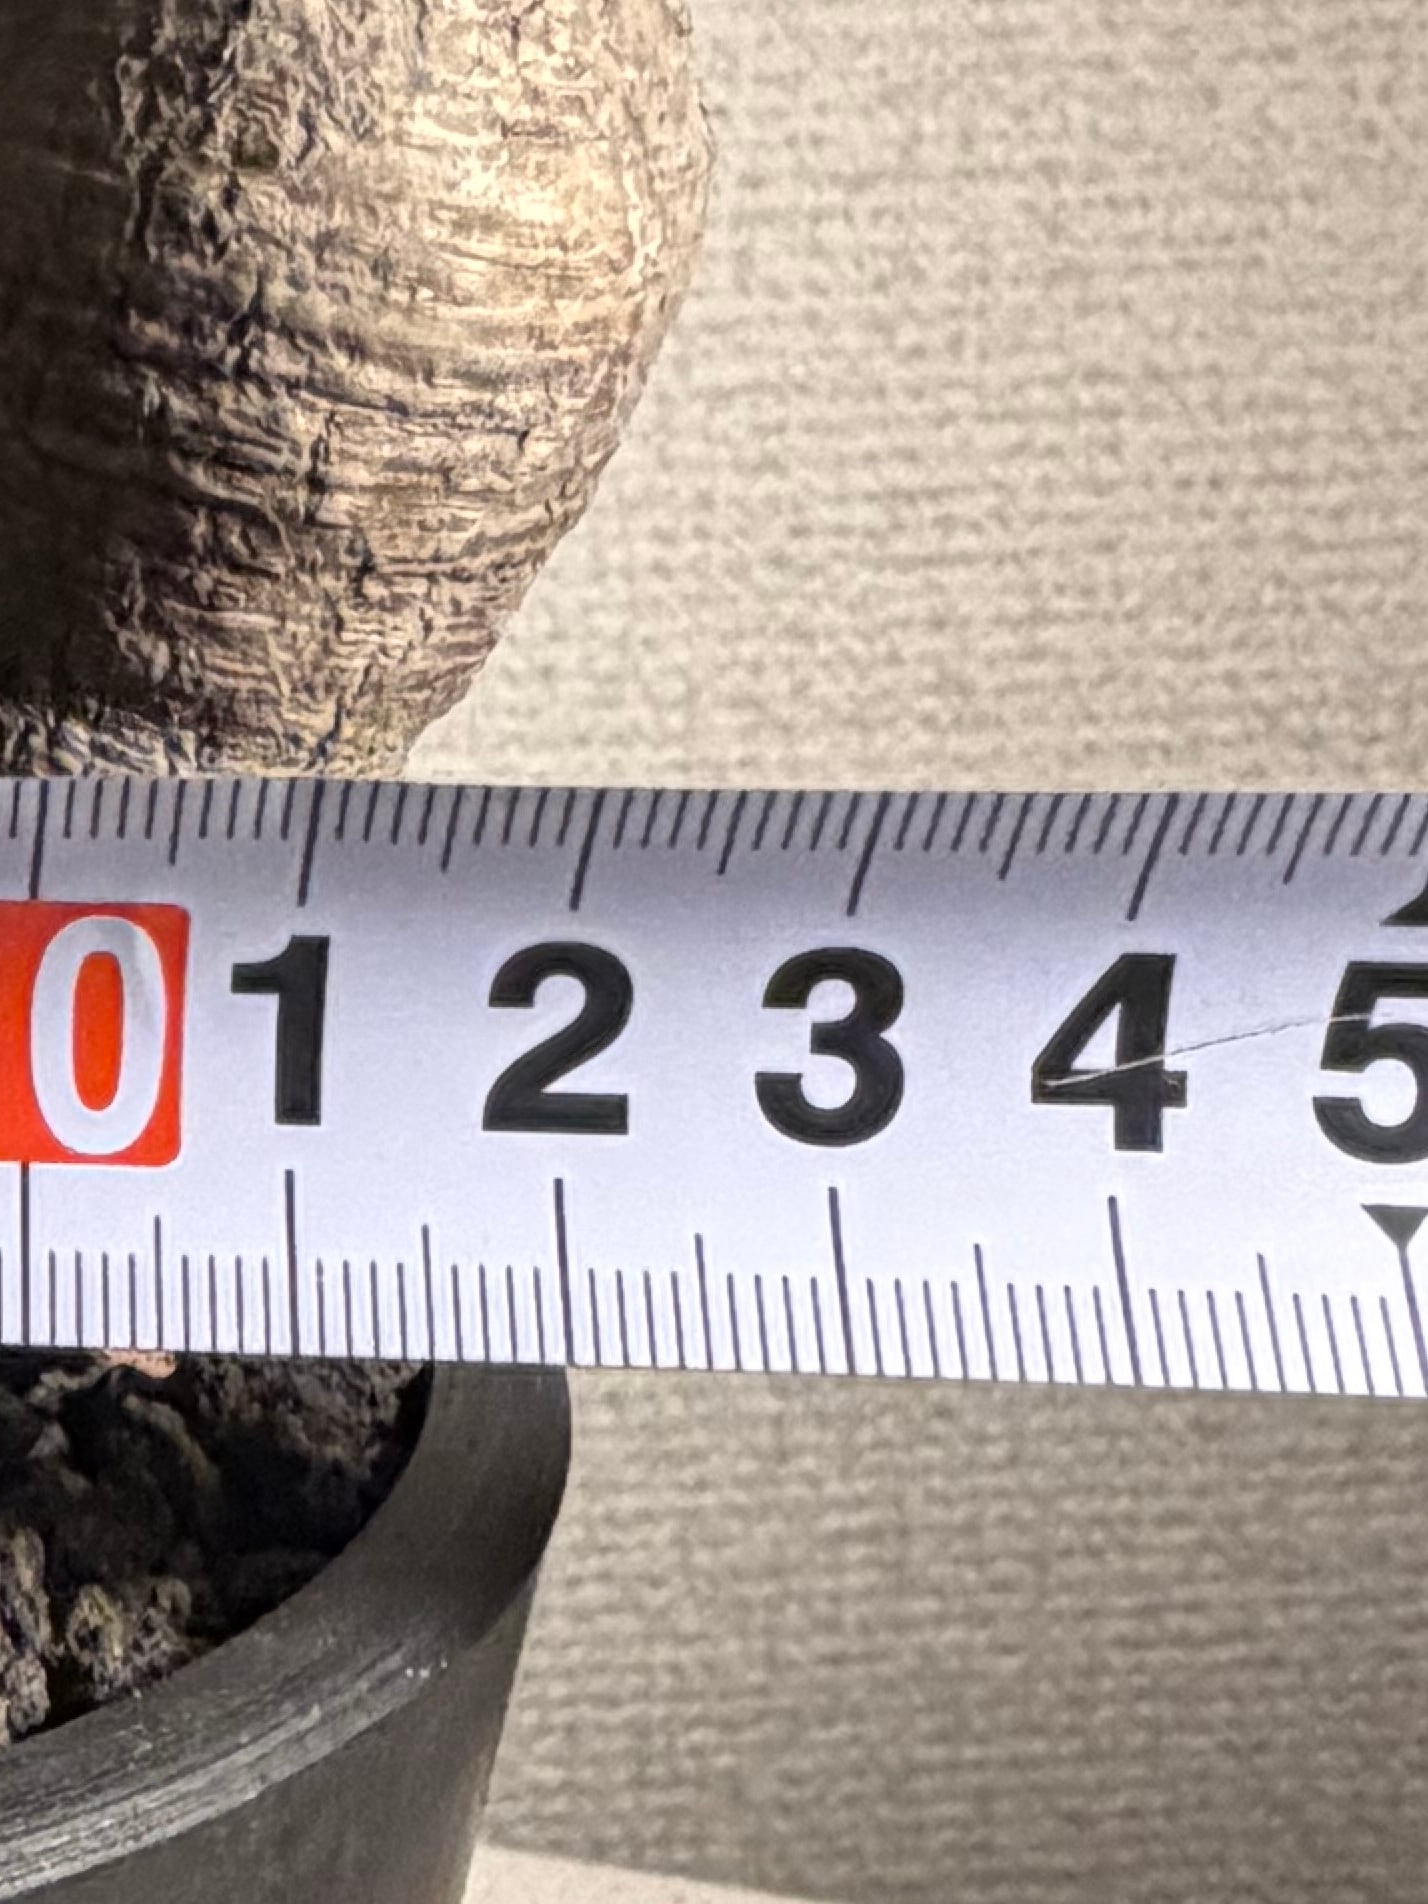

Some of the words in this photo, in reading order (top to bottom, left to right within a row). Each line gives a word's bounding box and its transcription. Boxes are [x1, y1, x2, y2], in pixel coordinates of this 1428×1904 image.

[229, 934, 330, 1126] 1
[481, 941, 634, 1135] 2
[754, 946, 905, 1146] 3
[1030, 952, 1188, 1152] 4
[1312, 960, 1428, 1164] 5
